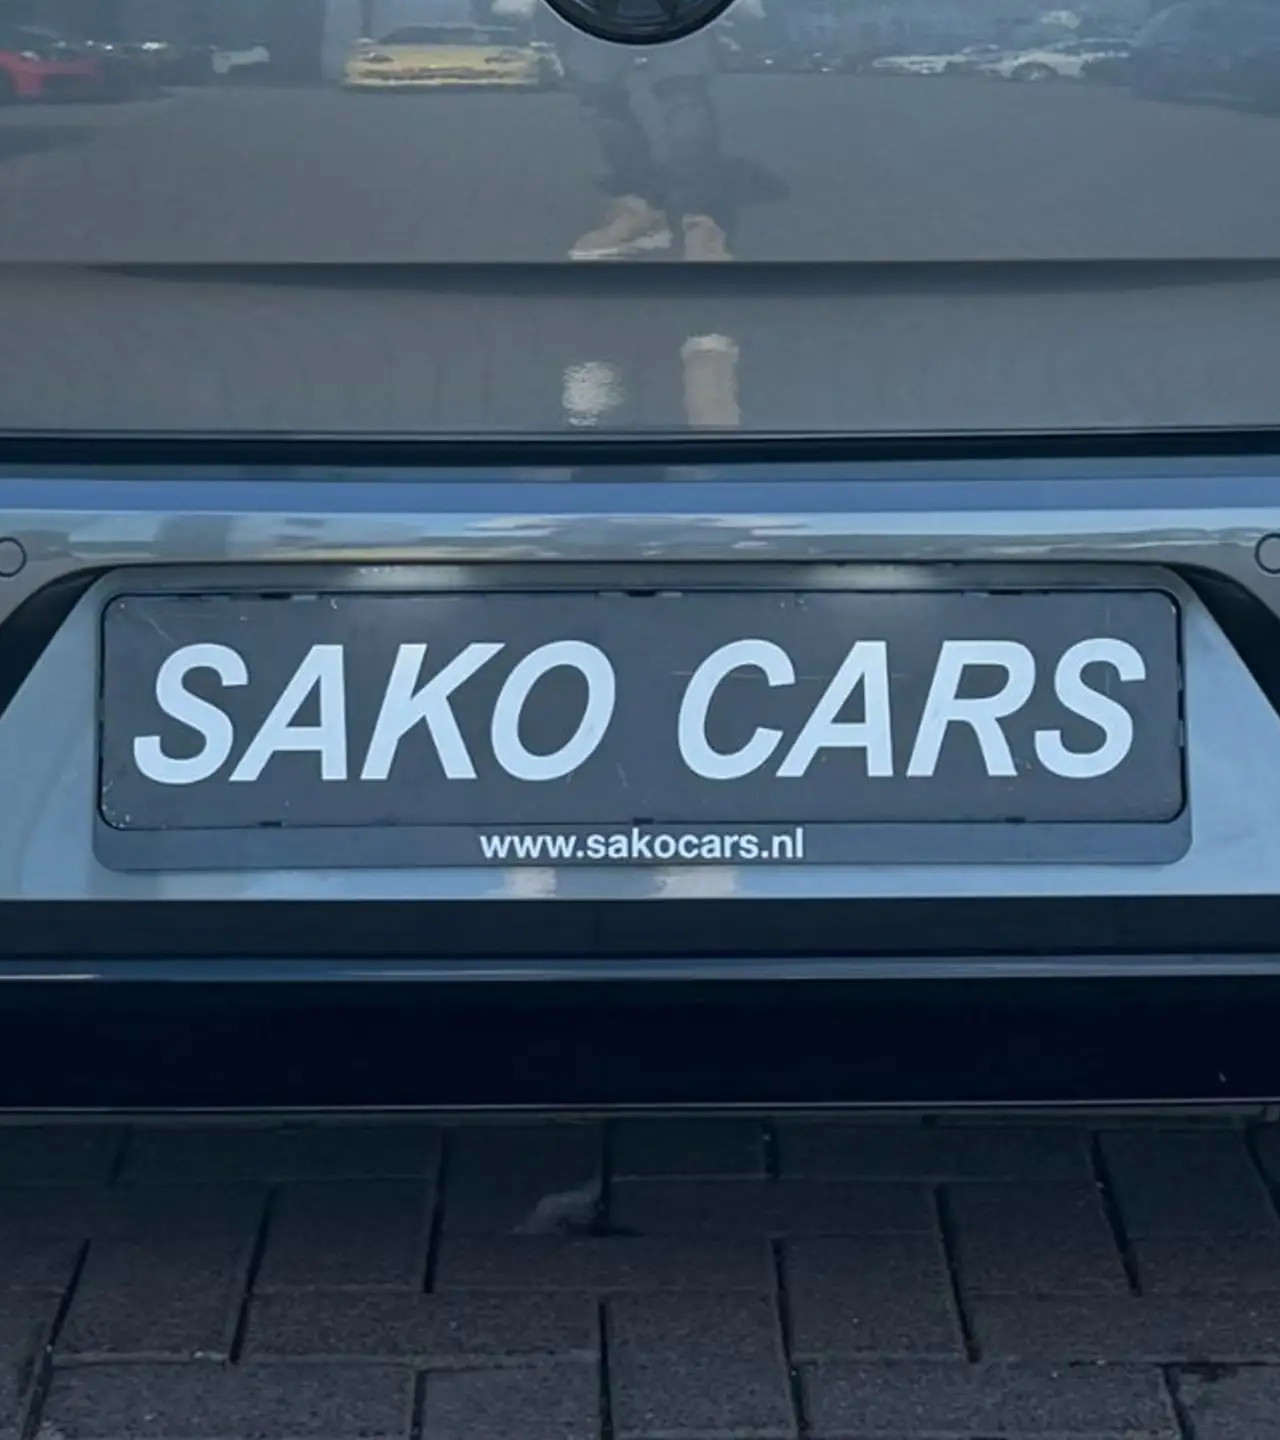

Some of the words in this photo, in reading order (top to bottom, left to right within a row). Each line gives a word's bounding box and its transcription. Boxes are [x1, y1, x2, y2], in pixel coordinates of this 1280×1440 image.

[132, 639, 616, 785] SAKO
[677, 637, 1147, 781] CARS
[478, 825, 805, 861] www.sakocars.nl
